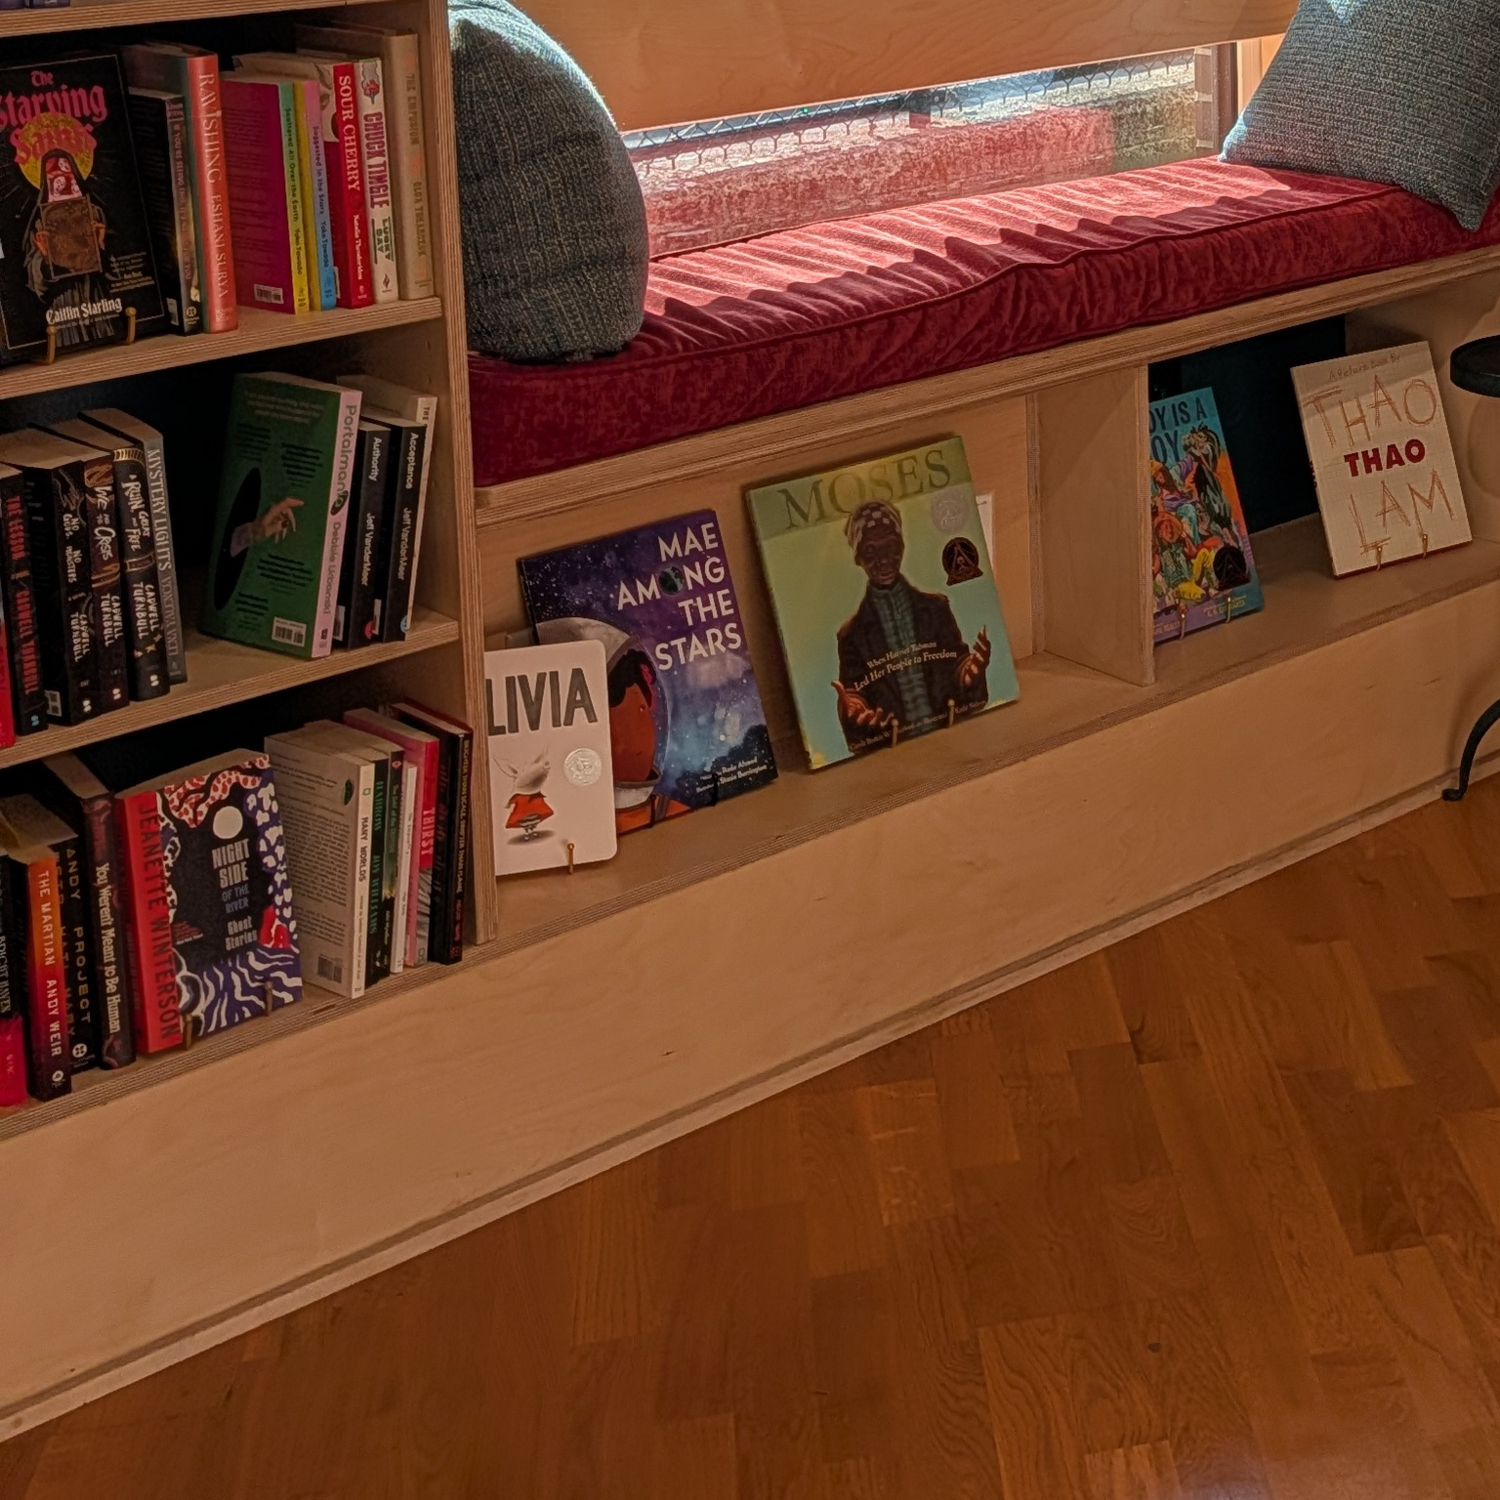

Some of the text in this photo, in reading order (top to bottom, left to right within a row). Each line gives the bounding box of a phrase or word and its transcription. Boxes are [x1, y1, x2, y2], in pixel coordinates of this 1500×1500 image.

[31, 70, 53, 86] The
[338, 75, 361, 191] SOUR CHERRY
[363, 111, 390, 209] CHUCK TINGLE
[199, 72, 229, 298] RAVISHING ESHANI SURYA
[46, 298, 123, 325] Caitlin Starling
[1303, 375, 1438, 448] THAO
[405, 433, 418, 490] Acceptance
[1343, 439, 1426, 477] THAO
[148, 447, 172, 571] MYSTERY LIGHTS
[323, 404, 357, 615] Portalmania Debbie Urbanski
[361, 437, 382, 587] Authority Jeff VanderMeer
[778, 449, 954, 529] MOSES
[1351, 469, 1456, 554] LAM
[658, 522, 718, 562] MAE
[616, 556, 726, 611] AMNG
[678, 590, 735, 627] THE
[655, 623, 742, 672] STARS
[854, 676, 870, 691] Led
[871, 668, 885, 682] Her
[887, 657, 912, 674] People
[923, 649, 957, 662] Freedom
[486, 666, 597, 736] LIVIA
[212, 838, 250, 870] NIGHT
[358, 817, 368, 883] MANY WORLDS
[421, 807, 436, 860] THIRST
[219, 863, 249, 888] SIDE
[140, 804, 180, 1041] JEANETTE WINTERSON
[225, 930, 258, 951] Stories
[227, 916, 253, 934] Ghost
[38, 869, 62, 1057] THE MARTIAN ANDY WEIR
